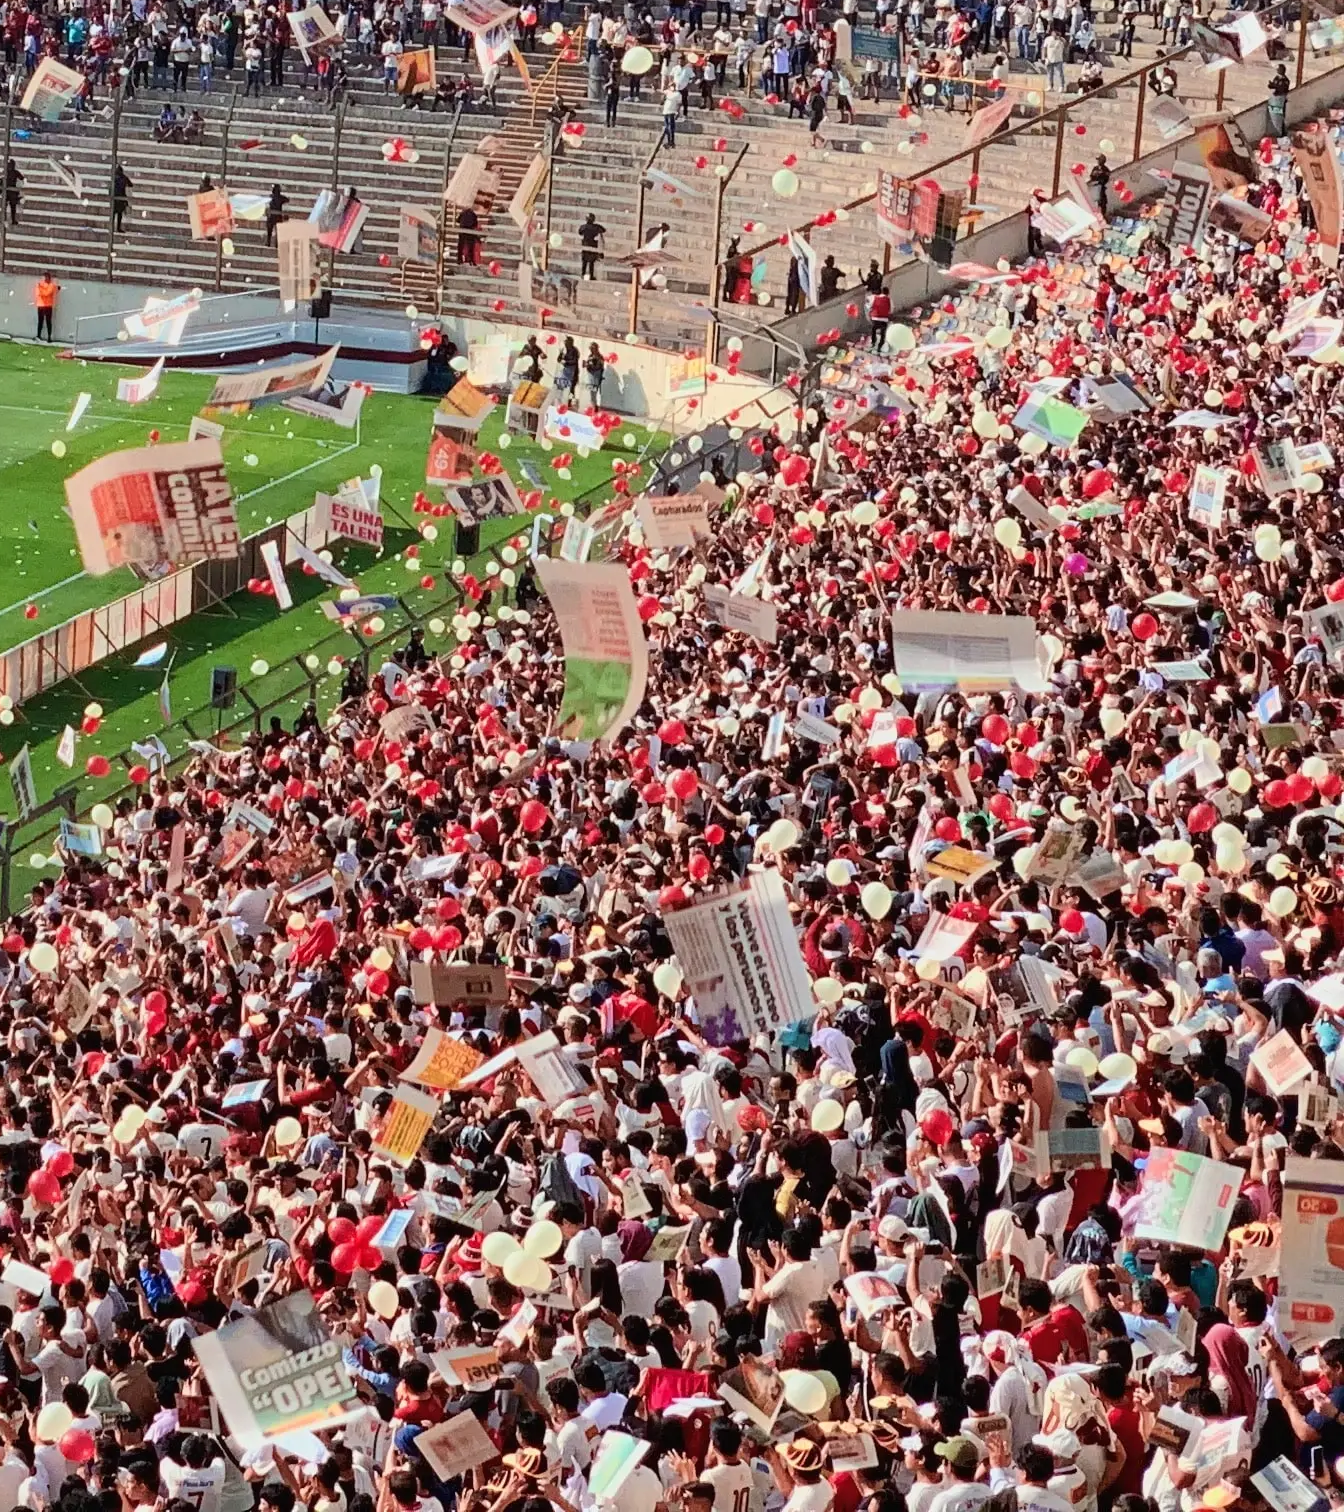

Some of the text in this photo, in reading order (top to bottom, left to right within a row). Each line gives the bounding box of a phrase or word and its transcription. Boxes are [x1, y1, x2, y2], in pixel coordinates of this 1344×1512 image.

[332, 503, 383, 528] ES UNA
[731, 942, 762, 1013] peruanos
[739, 900, 759, 954] Vuelve
[760, 972, 779, 1023] sorteo
[240, 1340, 337, 1391] Comizzo
